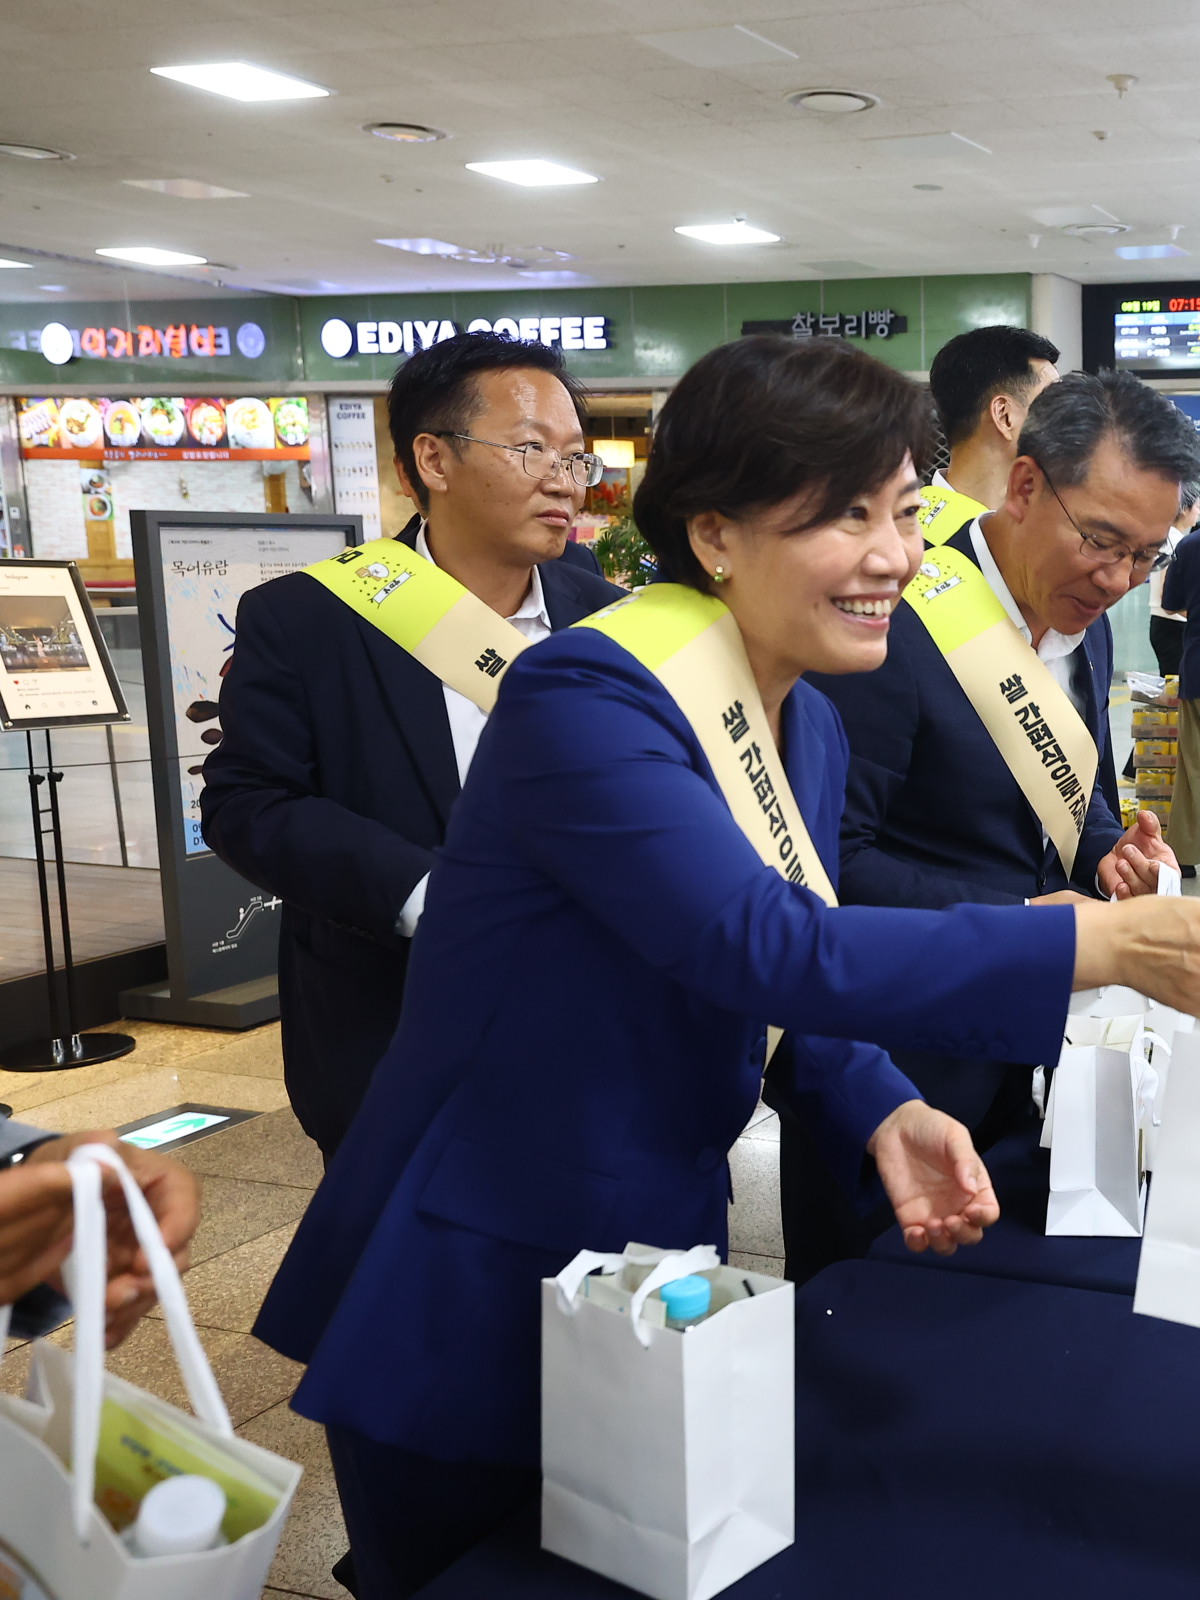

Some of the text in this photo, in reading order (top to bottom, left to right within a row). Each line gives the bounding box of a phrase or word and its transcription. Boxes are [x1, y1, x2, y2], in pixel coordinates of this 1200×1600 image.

[357, 320, 456, 353] EDIYA
[792, 309, 894, 340] 찰보리빵
[337, 412, 366, 420] COFFEE
[339, 403, 362, 412] EDIYA
[171, 560, 229, 577] 목어유람
[475, 648, 507, 678] 쌀
[721, 700, 750, 744] 쌀
[999, 673, 1081, 804] 쌀 간편식으로
